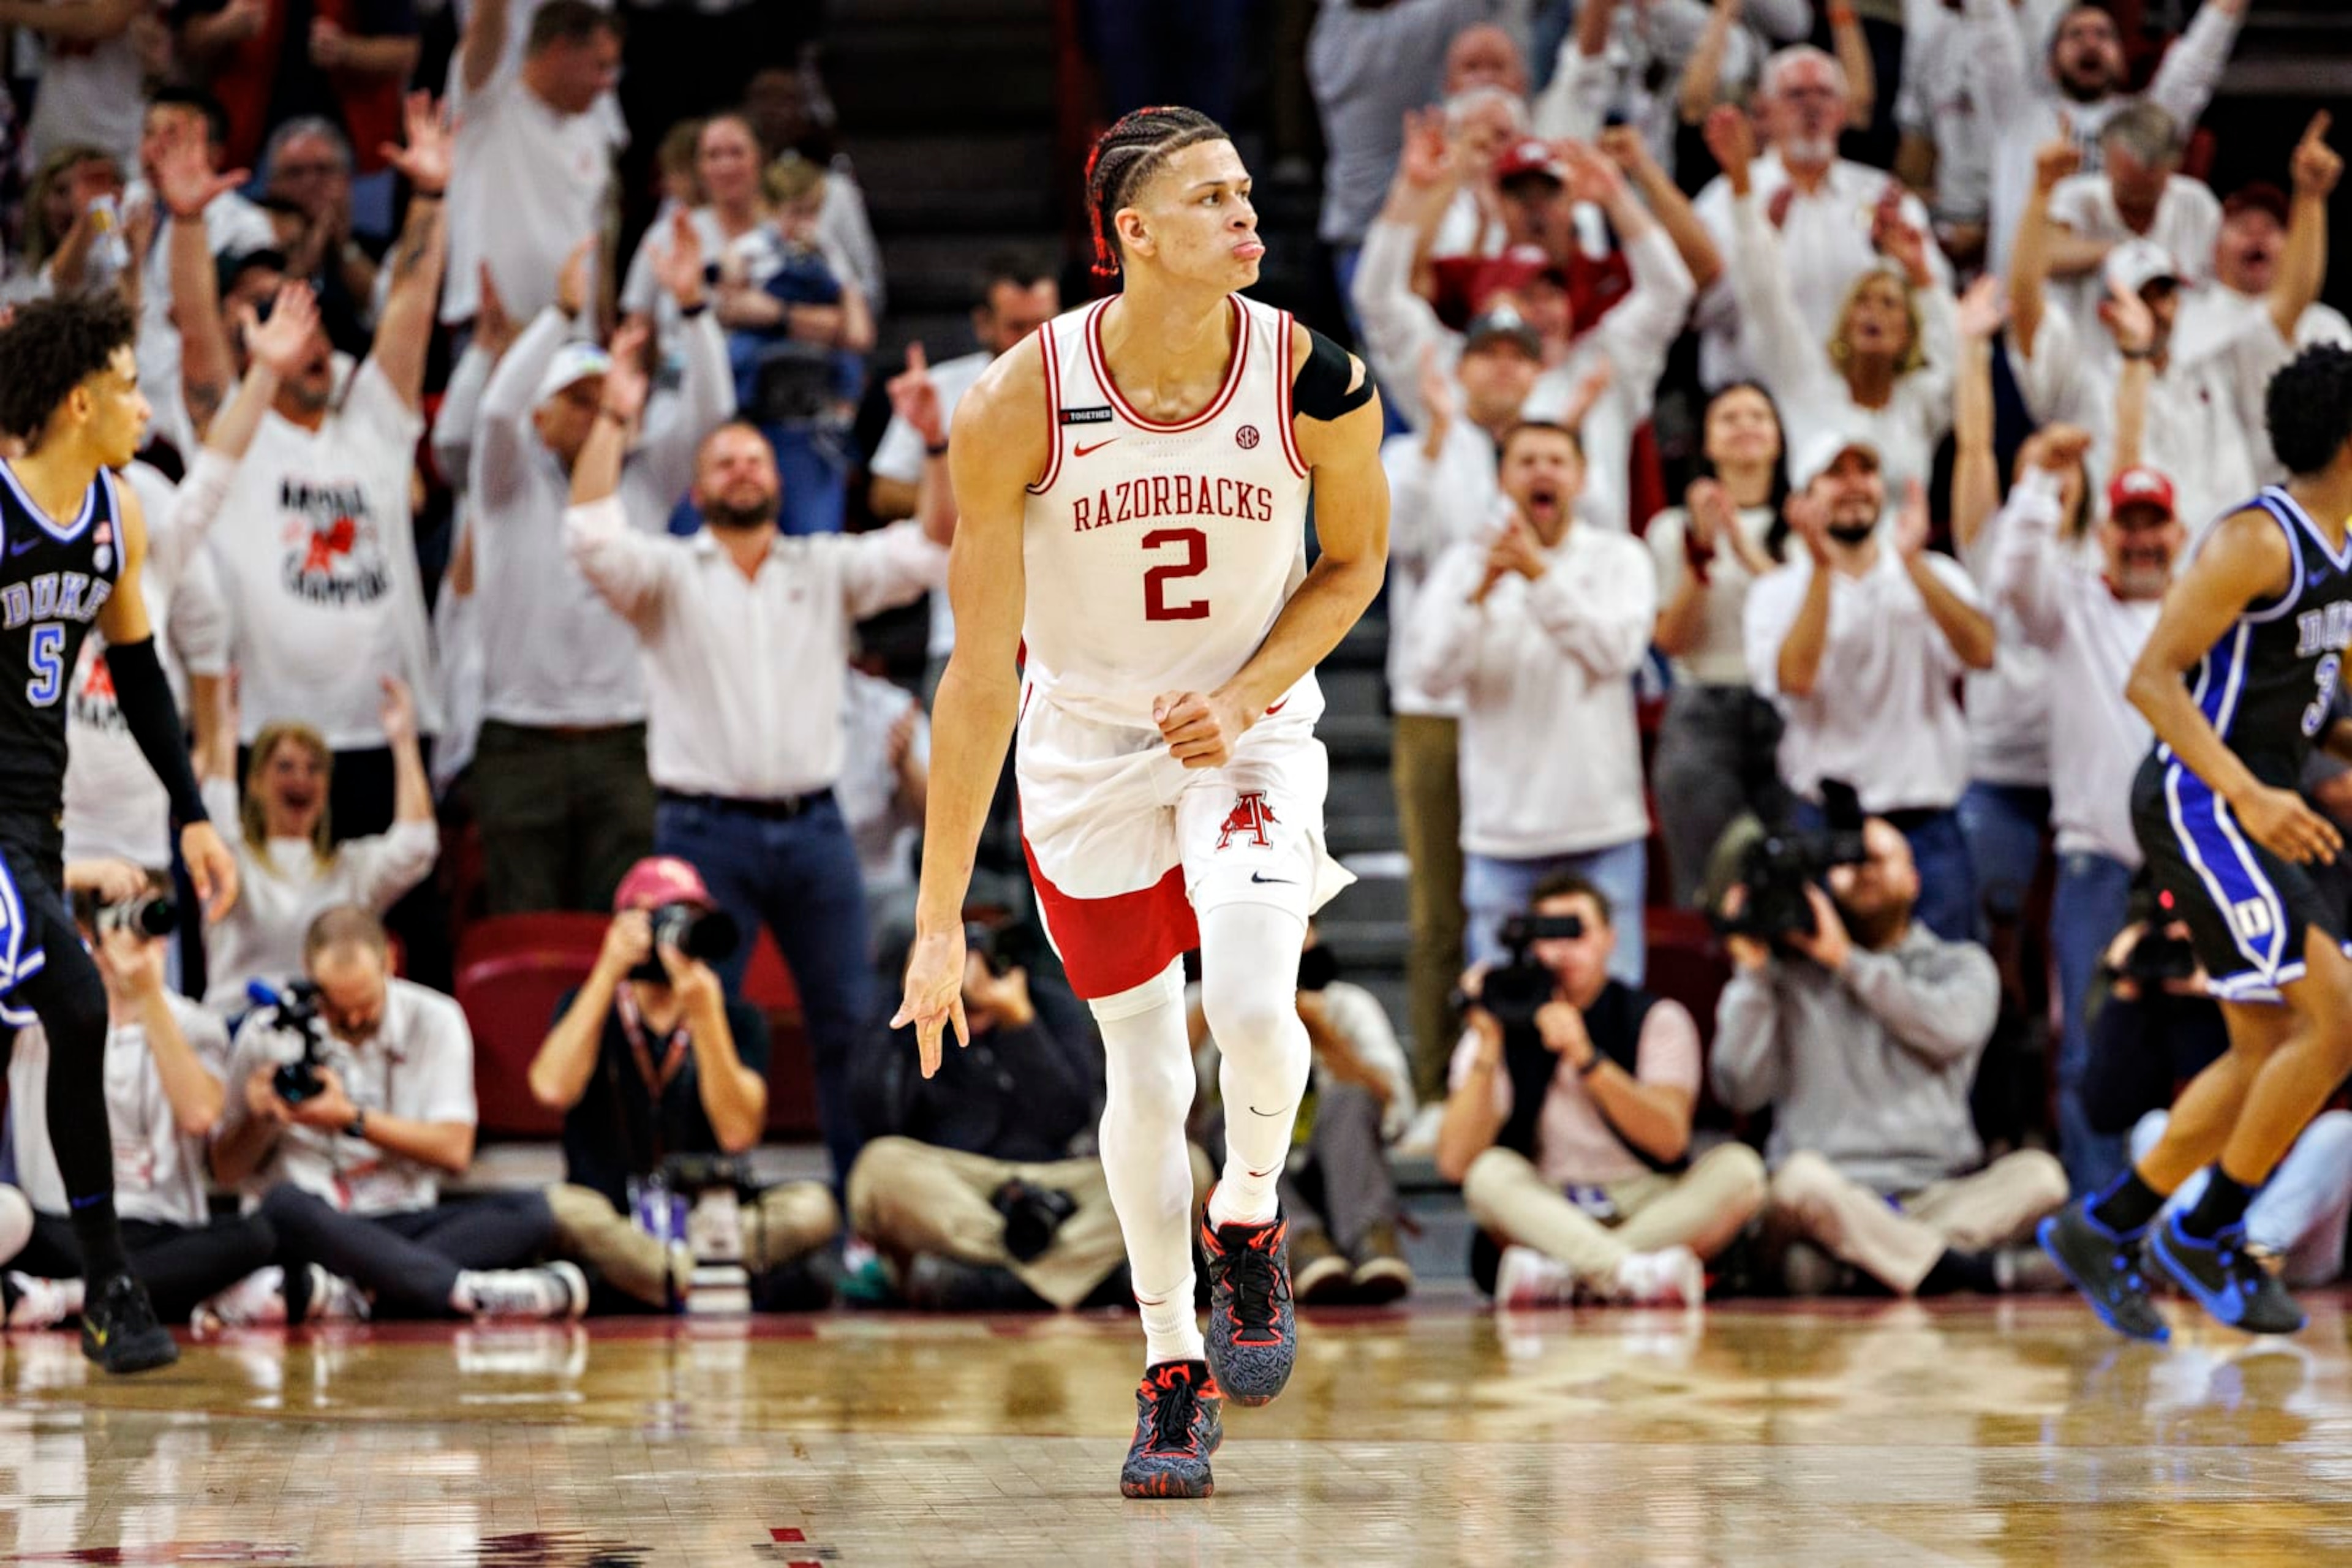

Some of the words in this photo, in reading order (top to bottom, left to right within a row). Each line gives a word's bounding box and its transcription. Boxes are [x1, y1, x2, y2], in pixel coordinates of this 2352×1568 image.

[1071, 409, 1111, 421] TOGETHER
[1237, 427, 1259, 448] SEC
[1073, 475, 1273, 532] RAZORBACKS
[1, 571, 112, 630] DUKE
[1142, 527, 1210, 621] 2
[26, 621, 66, 708] 5
